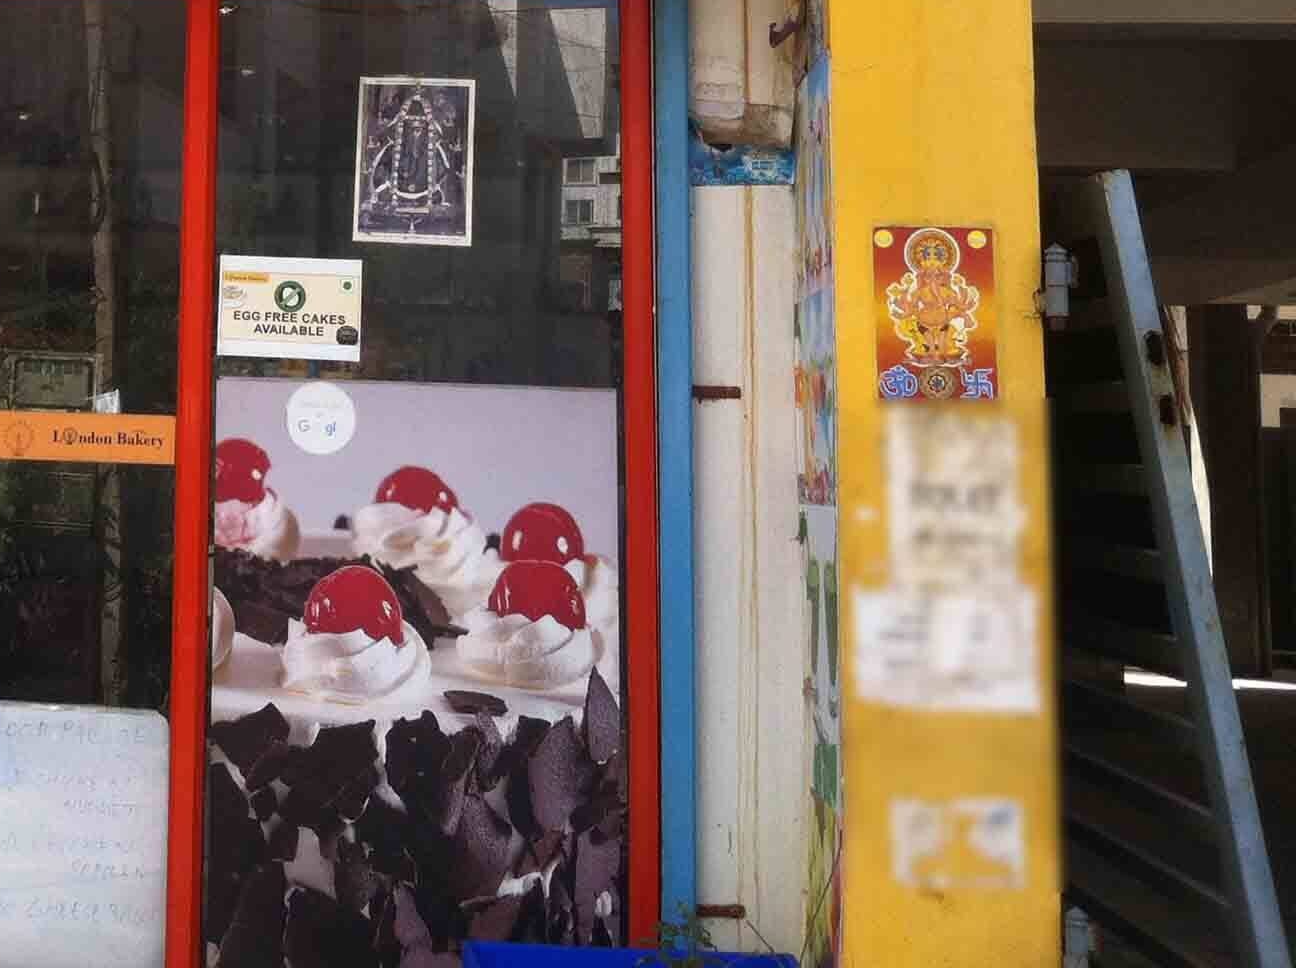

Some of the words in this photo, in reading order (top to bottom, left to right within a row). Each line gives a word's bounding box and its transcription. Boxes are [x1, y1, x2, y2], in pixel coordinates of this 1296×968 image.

[233, 310, 260, 322] EGG
[264, 311, 298, 324] FREE
[301, 313, 346, 326] CAKES
[254, 323, 324, 337] AVAILABLE
[52, 426, 112, 446] London
[116, 430, 166, 448] Bakery
